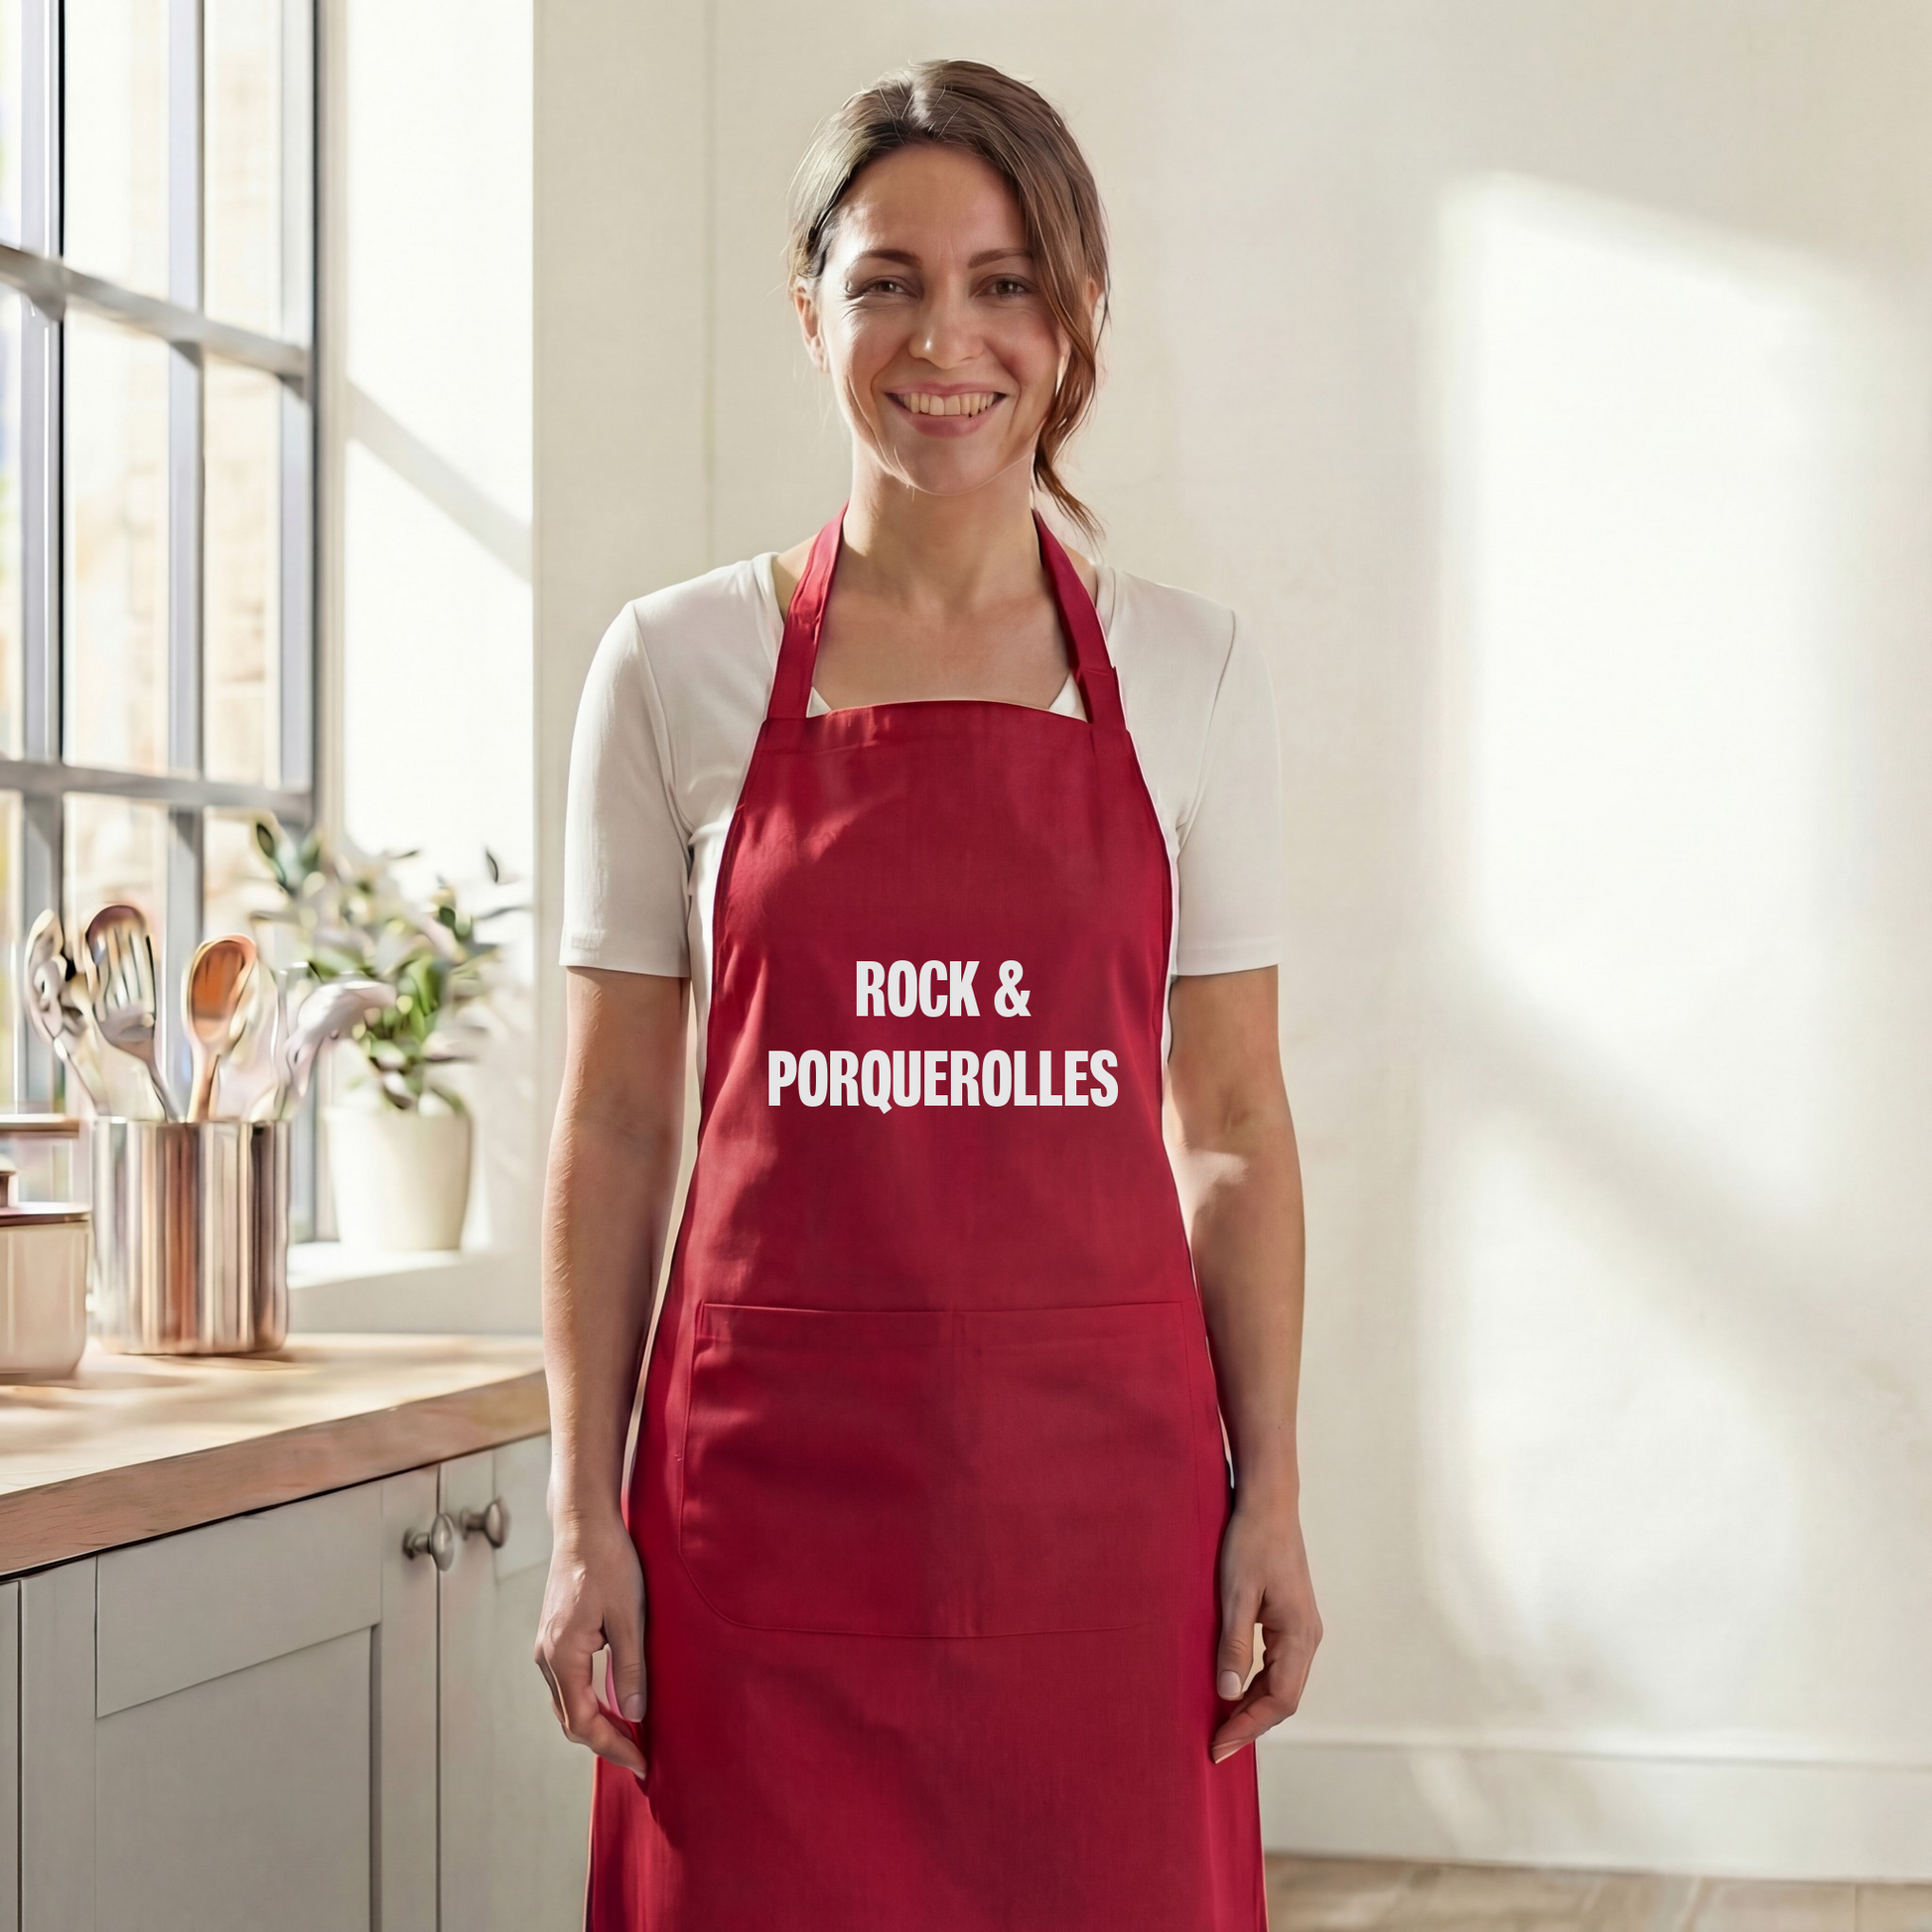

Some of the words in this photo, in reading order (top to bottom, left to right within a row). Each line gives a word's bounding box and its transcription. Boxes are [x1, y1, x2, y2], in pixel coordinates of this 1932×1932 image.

[856, 959, 980, 1018] ROCK
[994, 959, 1032, 1018] &
[767, 1049, 1119, 1114] PORQUEROLLES
